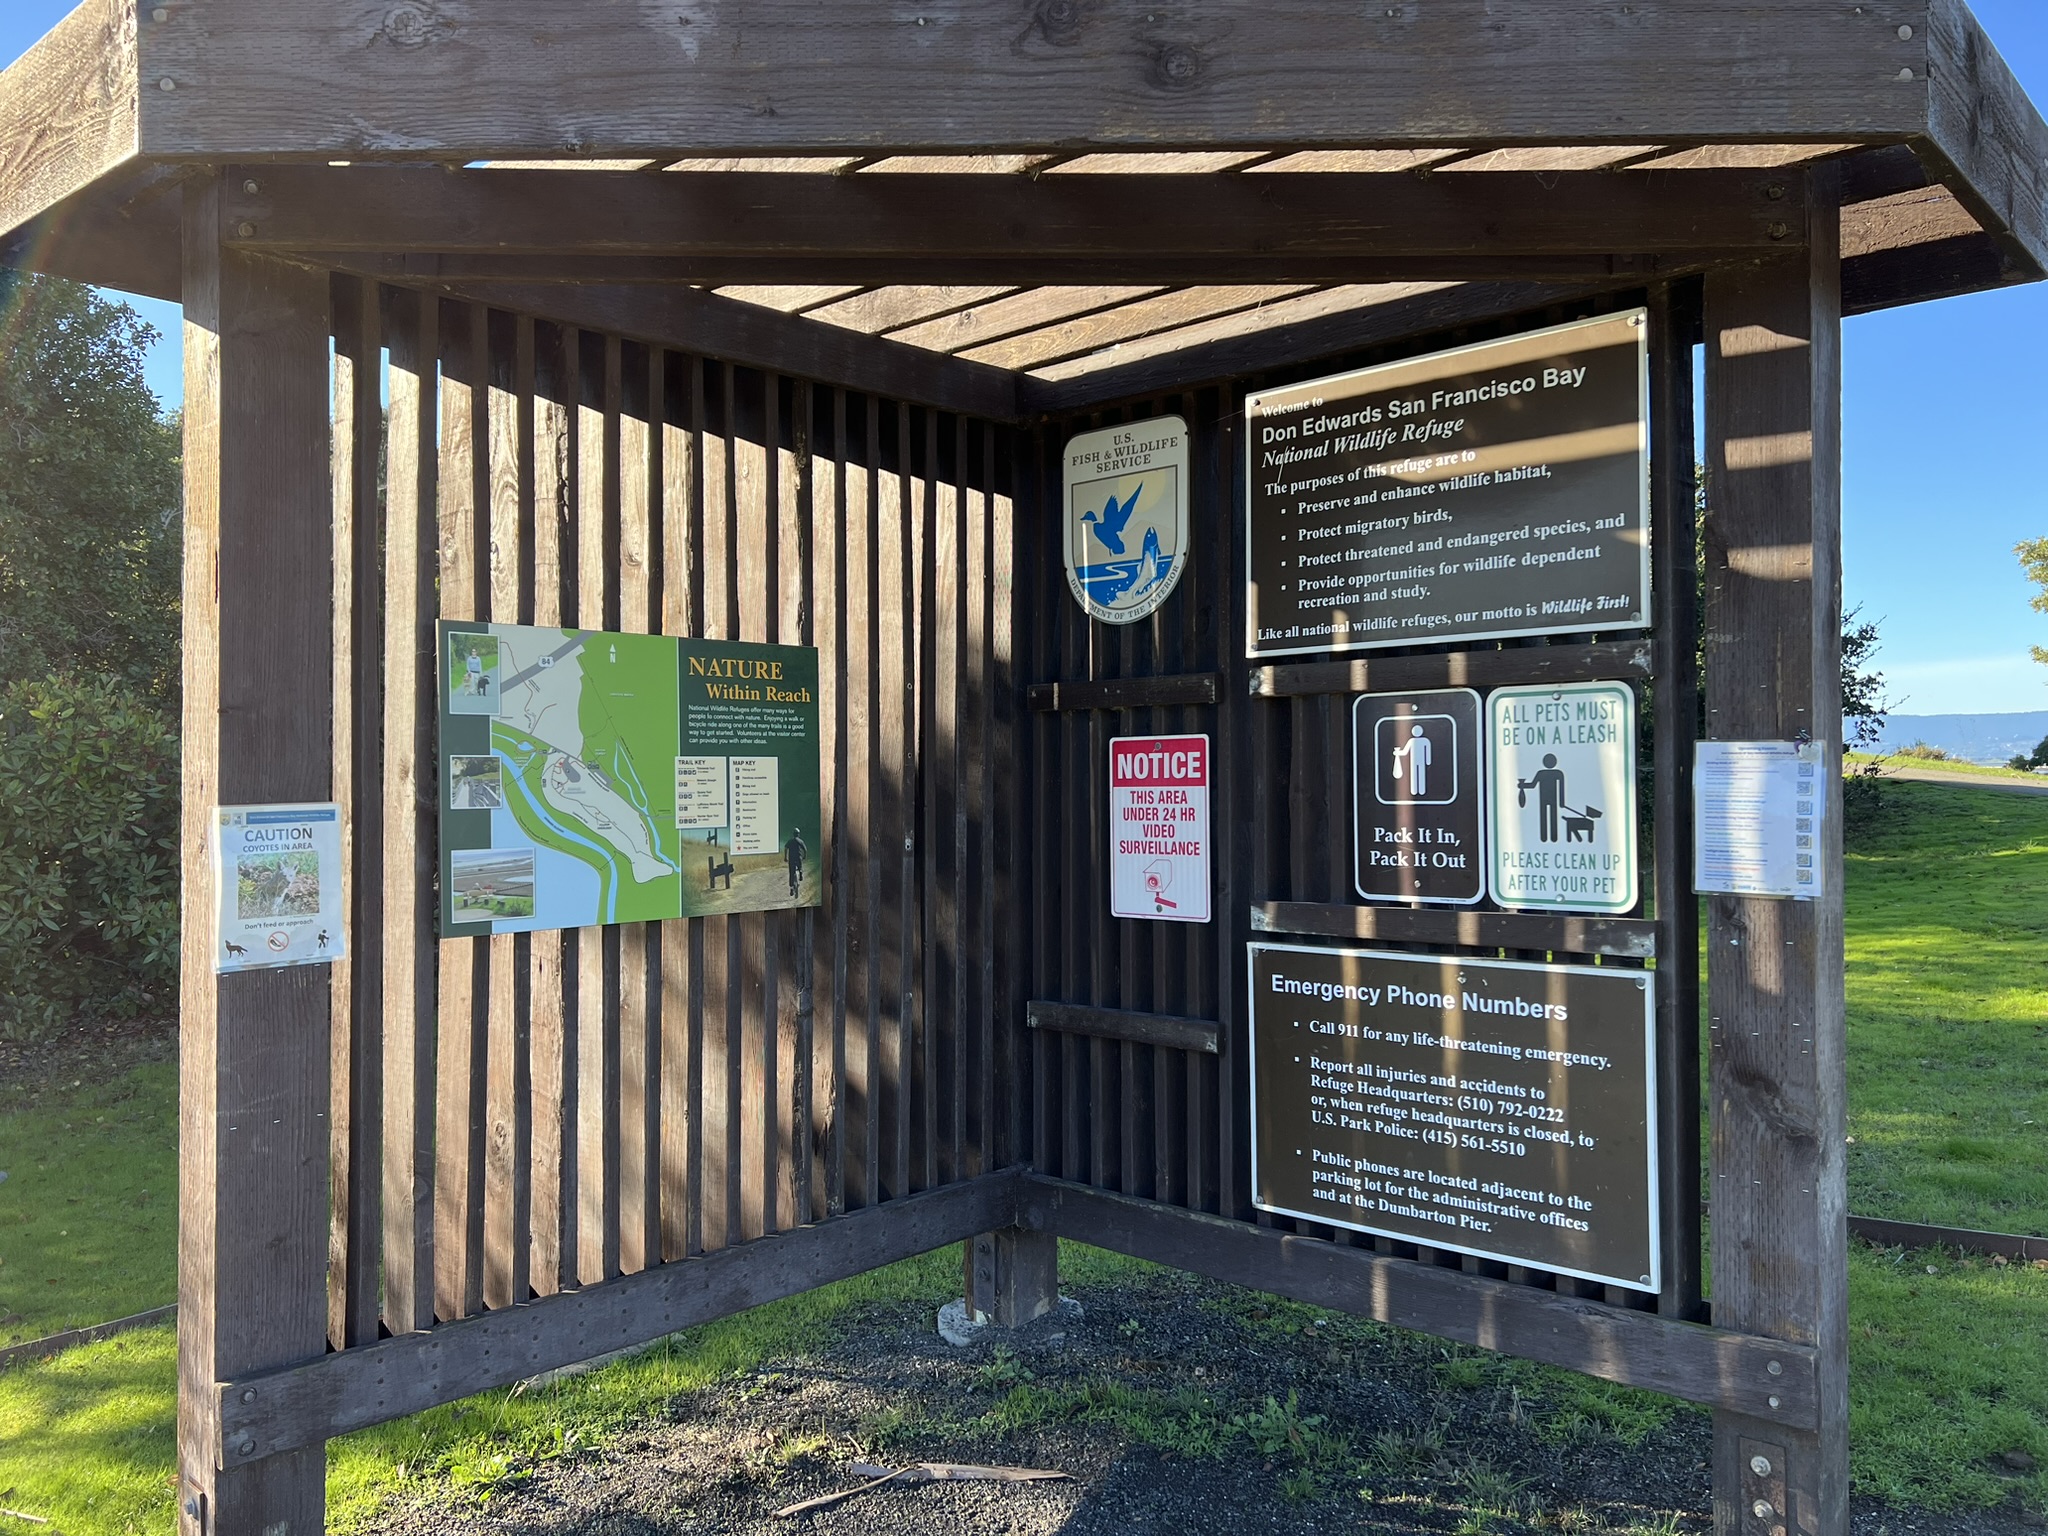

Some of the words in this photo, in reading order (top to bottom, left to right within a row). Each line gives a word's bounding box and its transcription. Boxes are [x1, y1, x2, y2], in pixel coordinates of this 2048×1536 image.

[1261, 401, 1309, 418] Welcome
[1312, 397, 1323, 407] to
[1263, 426, 1296, 444] Don
[1303, 406, 1382, 436] Edwards
[1388, 400, 1425, 418] San
[1432, 378, 1536, 410] Francisco
[1543, 367, 1586, 388] Bay
[1072, 452, 1100, 466] FISH
[1104, 450, 1112, 459] &
[1114, 437, 1178, 458] WILDLIFE
[1114, 433, 1134, 445] U.S.
[1262, 440, 1329, 468] National
[1334, 428, 1397, 454] Wildlife
[1400, 419, 1464, 443] Refuge
[1097, 454, 1151, 473] SERVICE
[1264, 480, 1287, 496] The
[1290, 474, 1344, 495] purposes
[1347, 468, 1361, 481] of
[1363, 464, 1386, 479] this
[1390, 459, 1433, 475] refuge
[1435, 454, 1458, 467] are
[1461, 450, 1476, 462] to
[1298, 498, 1350, 514] Preserve
[1353, 490, 1377, 505] and
[1381, 484, 1435, 501] enhance
[1438, 473, 1490, 492] wildlife
[1494, 464, 1551, 483] habitat,
[1298, 524, 1342, 541] Protect
[1345, 516, 1410, 535] migratory
[1413, 508, 1453, 524] birds,
[1298, 552, 1342, 567] Protect
[1345, 541, 1413, 561] threatened
[1417, 537, 1443, 552] and
[1447, 525, 1529, 548] endangered
[1533, 520, 1591, 540] species,
[1595, 513, 1625, 530] and
[1298, 575, 1345, 591] Provide
[1348, 565, 1435, 588] opportunities
[1439, 562, 1460, 575] for
[1463, 554, 1516, 572] wildlife
[1521, 545, 1601, 568] dependent
[1071, 579, 1112, 618] DEPAMENT
[1128, 606, 1146, 617] THE
[1147, 565, 1179, 608] INTERIOR
[1298, 592, 1359, 609] recreation
[1363, 588, 1387, 602] and
[1391, 584, 1430, 600] study.
[1258, 628, 1282, 640] Like
[1285, 626, 1299, 637] all
[1302, 621, 1349, 636] national
[1352, 617, 1398, 631] wildlife
[1401, 614, 1451, 628] refuges,
[1455, 612, 1479, 622] our
[1482, 607, 1522, 620] motto
[1526, 603, 1537, 616] is
[1542, 598, 1593, 614] Wildlife
[1596, 594, 1629, 610] First!
[610, 653, 615, 663] N
[688, 657, 783, 680] NATURE
[705, 683, 760, 700] Within
[766, 686, 810, 702] Reach
[1502, 705, 1529, 724] ALL
[1536, 703, 1569, 722] PETS
[1576, 700, 1616, 721] MUST
[1503, 727, 1520, 746] BE
[1526, 726, 1545, 745] ON
[1552, 726, 1562, 744] A
[1568, 724, 1616, 744] LEASH
[1117, 752, 1201, 779] NOTICE
[1130, 791, 1154, 805] THIS
[1158, 790, 1188, 804] AREA
[1123, 807, 1159, 821] UNDER
[1163, 808, 1176, 821] 24
[1180, 807, 1195, 821] HR
[244, 828, 312, 842] CAUTION
[1142, 824, 1175, 838] VIDEO
[1374, 827, 1413, 843] Pack
[1418, 828, 1431, 843] It
[1436, 828, 1460, 847] In,
[242, 844, 279, 853] COYOTES
[291, 842, 313, 850] AREA
[1119, 840, 1200, 856] SURVEILLANCE
[1370, 851, 1409, 866] Pack
[1413, 852, 1427, 867] It
[1432, 852, 1466, 868] Out
[1503, 852, 1549, 869] PLEASE
[1554, 853, 1596, 870] CLEAN
[1602, 854, 1621, 871] UP
[1508, 874, 1546, 891] AFTER
[1551, 876, 1587, 893] YOUR
[1593, 877, 1616, 894] PET
[285, 918, 313, 927] approach
[1272, 974, 1381, 1006] Emergency
[1387, 985, 1455, 1009] Phone
[1462, 992, 1567, 1020] Numbers
[1309, 1020, 1335, 1034] Call
[1338, 1024, 1358, 1037] 911
[1363, 1026, 1382, 1040] for
[1385, 1032, 1409, 1046] any
[1412, 1032, 1521, 1060] life-threatening
[1525, 1048, 1611, 1070] emergency.
[1310, 1056, 1353, 1074] Report
[1356, 1064, 1372, 1076] all
[1376, 1065, 1426, 1084] injuries
[1430, 1075, 1456, 1087] and
[1460, 1079, 1526, 1097] accidents
[1530, 1087, 1545, 1100] to
[1311, 1074, 1354, 1094] Refuge
[1357, 1081, 1453, 1107] Headquarters:
[1457, 1095, 1493, 1115] (510)
[1497, 1101, 1564, 1122] 792-0222
[1311, 1096, 1327, 1108] or,
[1330, 1096, 1363, 1111] when
[1367, 1103, 1408, 1121] refuge
[1411, 1107, 1504, 1133] headquarters
[1508, 1122, 1520, 1136] is
[1523, 1125, 1574, 1147] closed,
[1578, 1131, 1594, 1147] to
[1311, 1110, 1337, 1126] U.S.
[1340, 1115, 1371, 1131] Park
[1374, 1120, 1418, 1139] Police:
[1422, 1128, 1457, 1148] (415)
[1461, 1134, 1525, 1156] 561-5510
[1312, 1149, 1351, 1168] Public
[1354, 1158, 1399, 1176] phones
[1403, 1169, 1425, 1181] are
[1428, 1170, 1477, 1191] located
[1481, 1182, 1544, 1203] adjacent
[1548, 1193, 1563, 1206] to
[1567, 1195, 1592, 1211] the
[1312, 1171, 1361, 1191] parking
[1364, 1177, 1381, 1192] lot
[1385, 1181, 1405, 1196] for
[1408, 1186, 1429, 1201] the
[1432, 1192, 1536, 1221] administrative
[1539, 1211, 1589, 1231] offices
[1312, 1189, 1335, 1201] and
[1339, 1193, 1351, 1204] at
[1354, 1194, 1375, 1209] the
[1378, 1198, 1456, 1225] Dumbarton
[1460, 1214, 1492, 1232] Pier.
